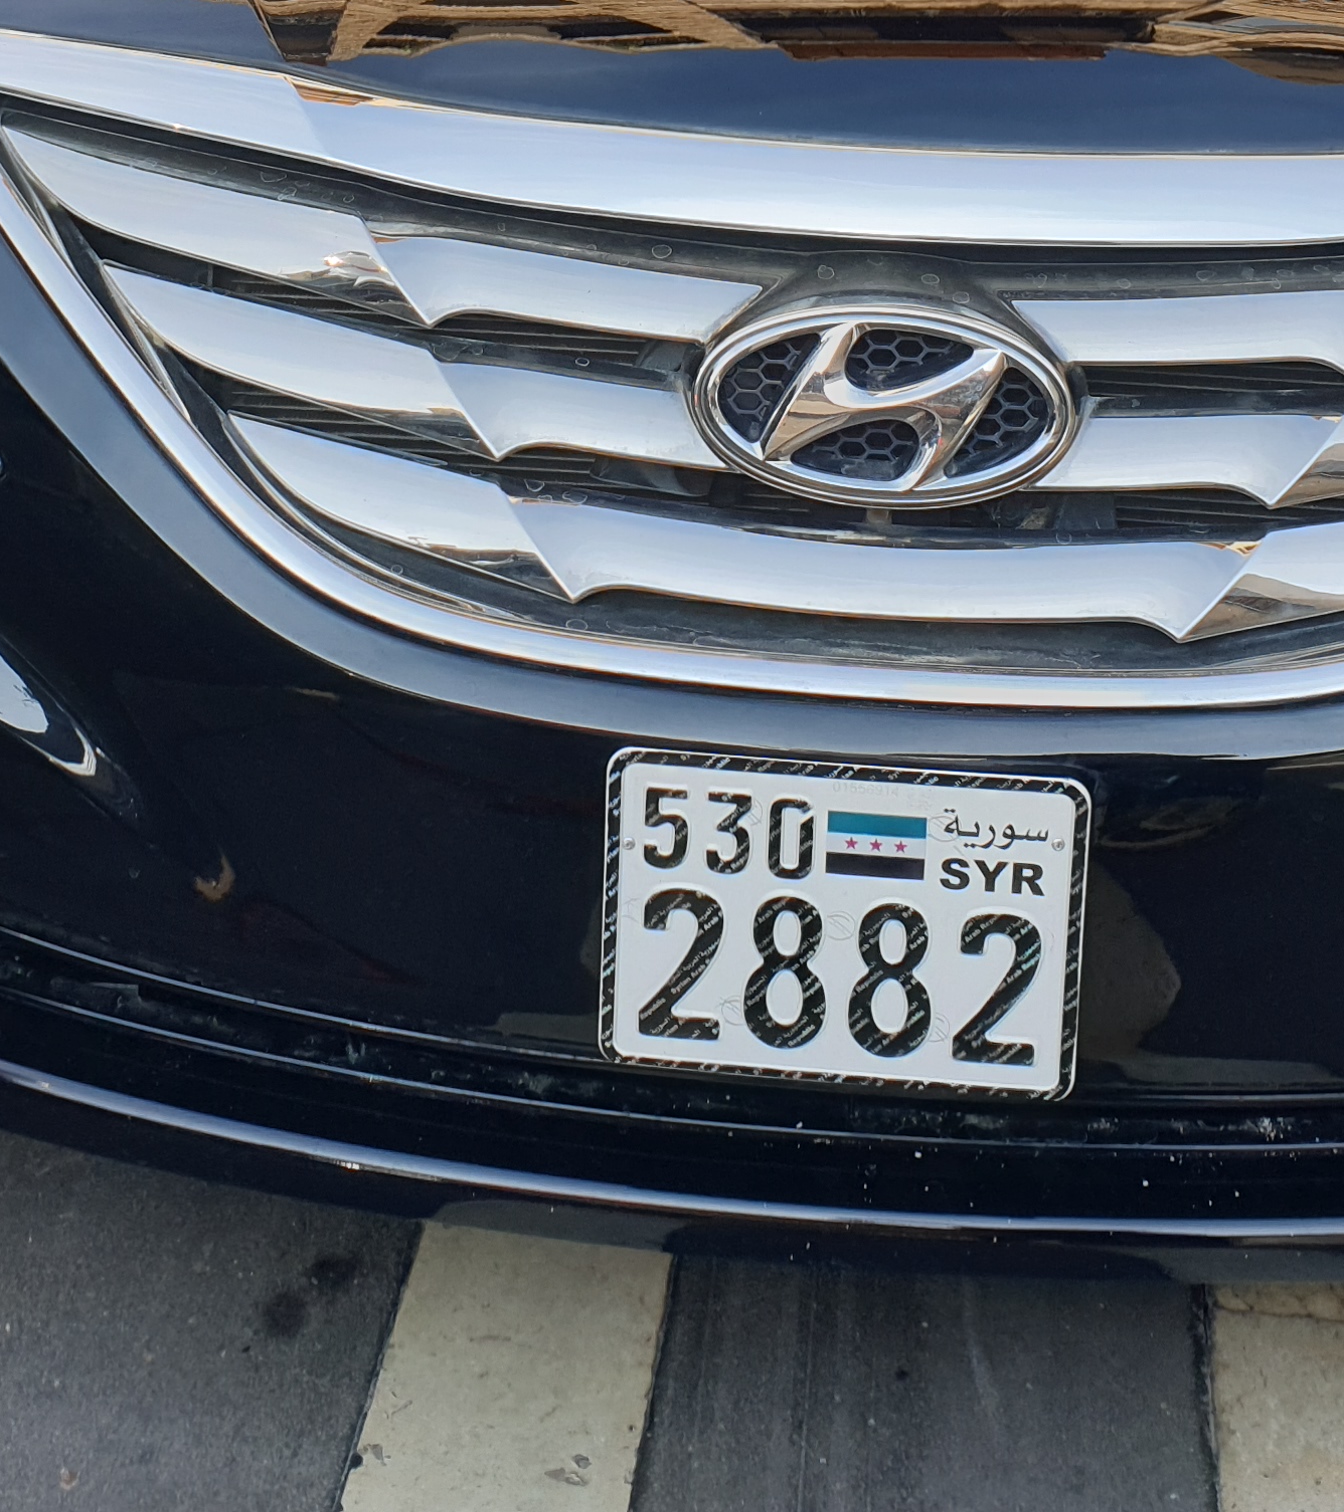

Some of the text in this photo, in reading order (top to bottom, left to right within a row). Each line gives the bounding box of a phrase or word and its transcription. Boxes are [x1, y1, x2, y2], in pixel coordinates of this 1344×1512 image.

[644, 787, 814, 879] 530
[944, 808, 1049, 850] سورية
[939, 857, 1045, 897] SYR
[639, 888, 1042, 1066] 2882
